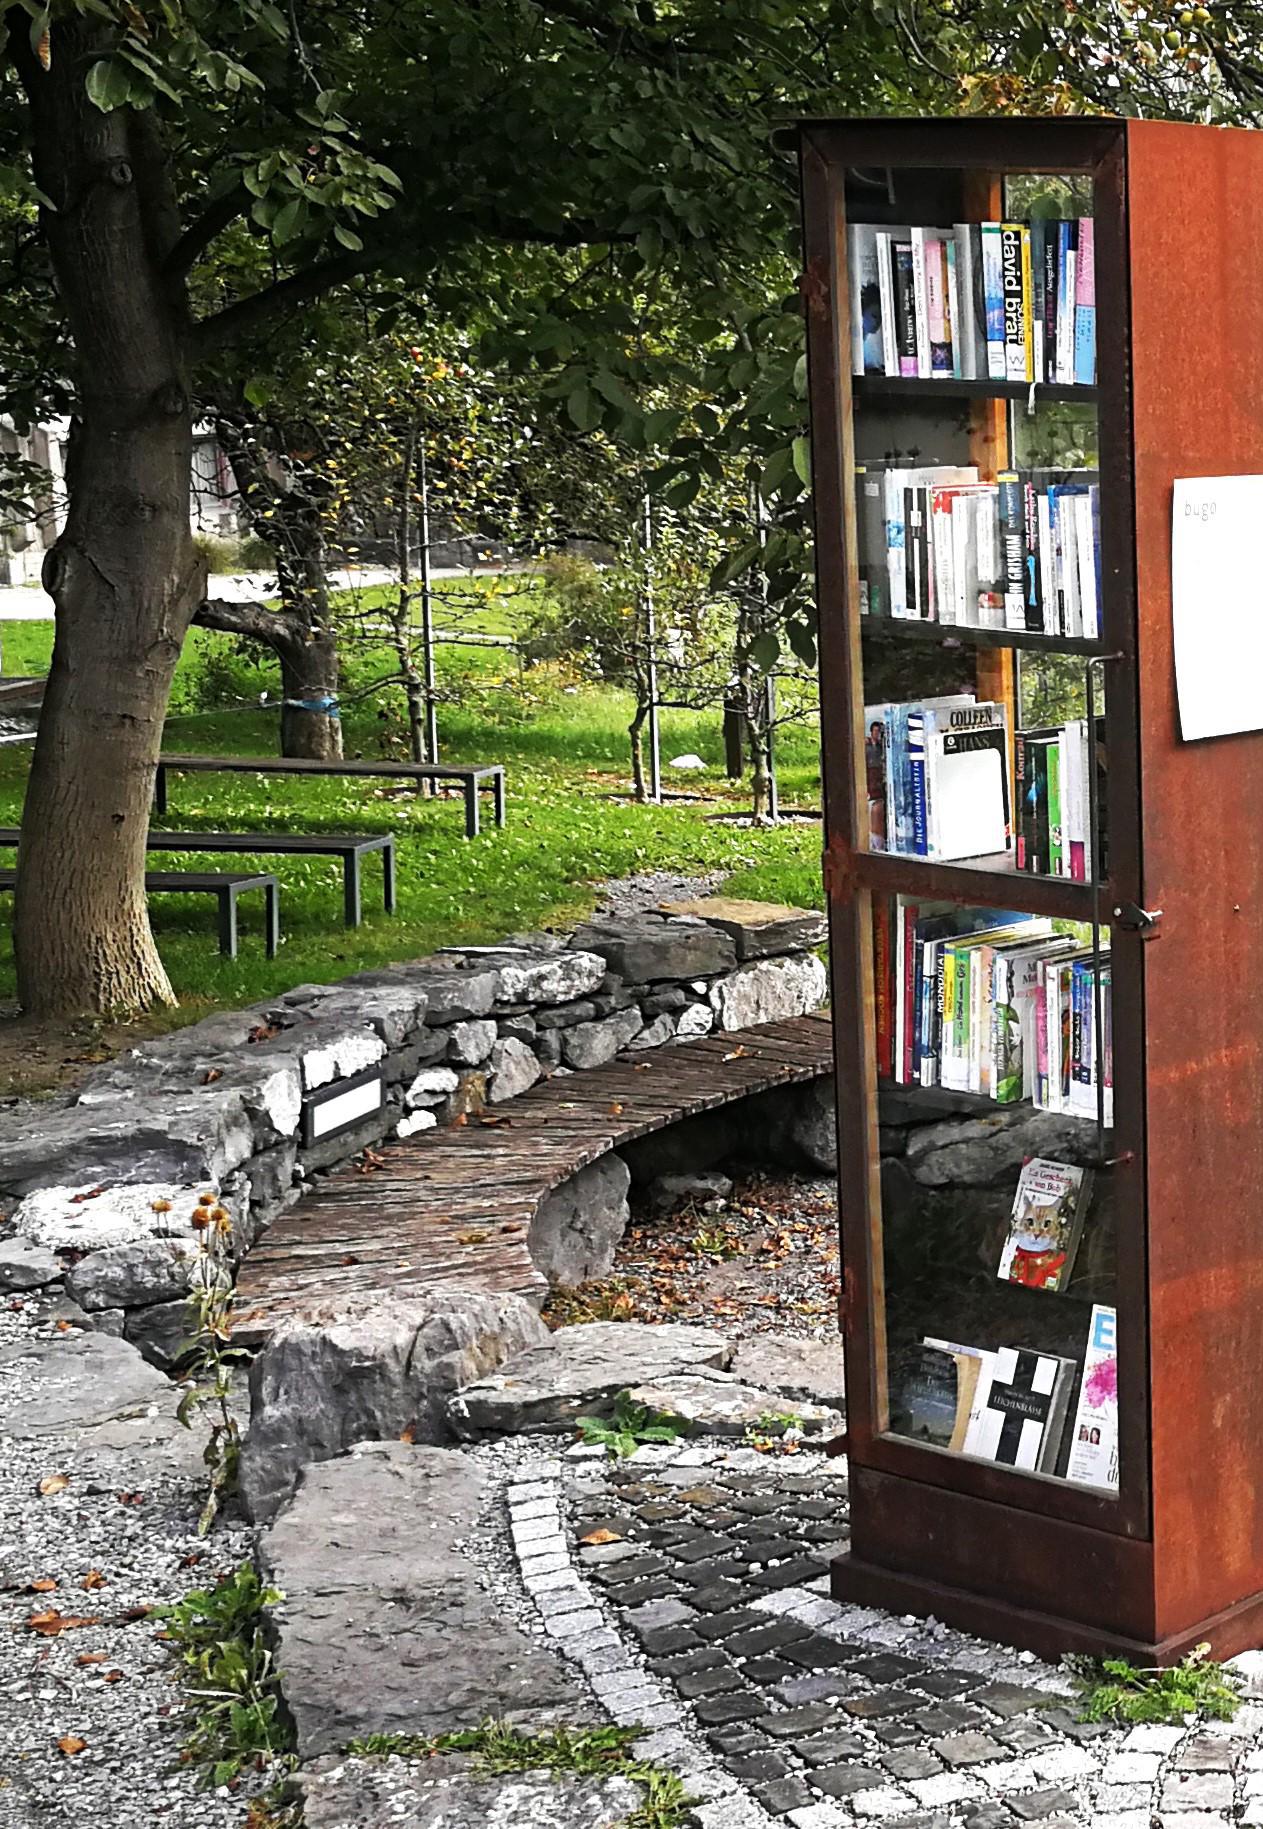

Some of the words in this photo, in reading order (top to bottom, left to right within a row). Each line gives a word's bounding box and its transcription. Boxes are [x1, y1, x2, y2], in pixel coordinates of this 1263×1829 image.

[1002, 230, 1021, 291] david
[1005, 534, 1023, 580] GRISHAM
[950, 705, 992, 728] COLLEEN
